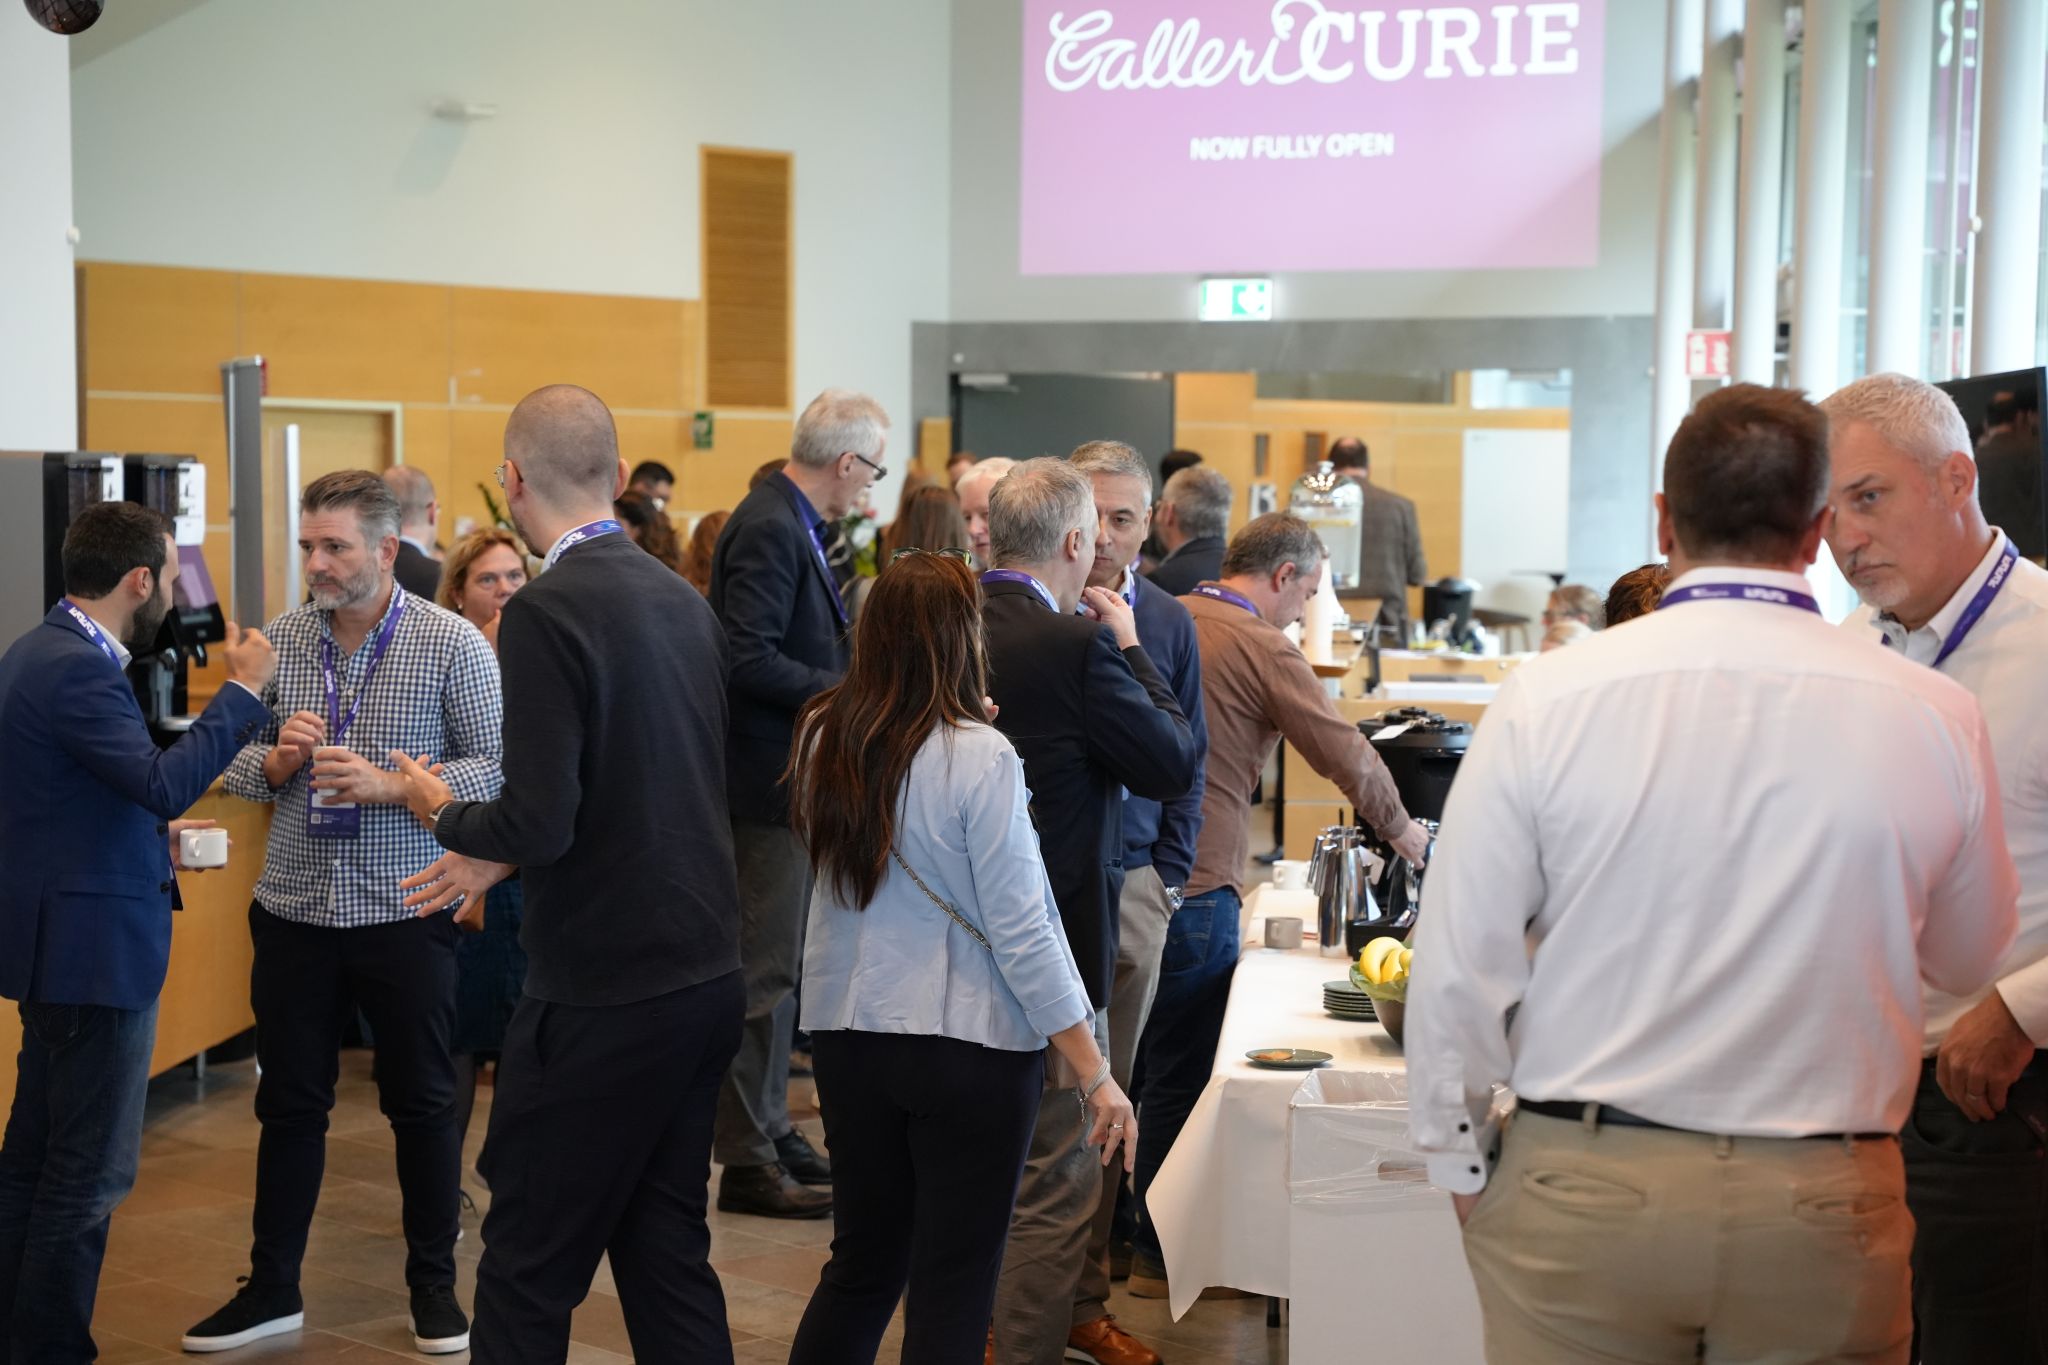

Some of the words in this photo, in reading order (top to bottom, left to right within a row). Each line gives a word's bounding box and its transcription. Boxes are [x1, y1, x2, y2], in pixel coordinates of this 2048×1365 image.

[1299, 3, 1579, 84] CURIE
[1190, 136, 1250, 161] NOW
[1252, 134, 1324, 160] FULLY
[1325, 132, 1394, 158] OPEN
